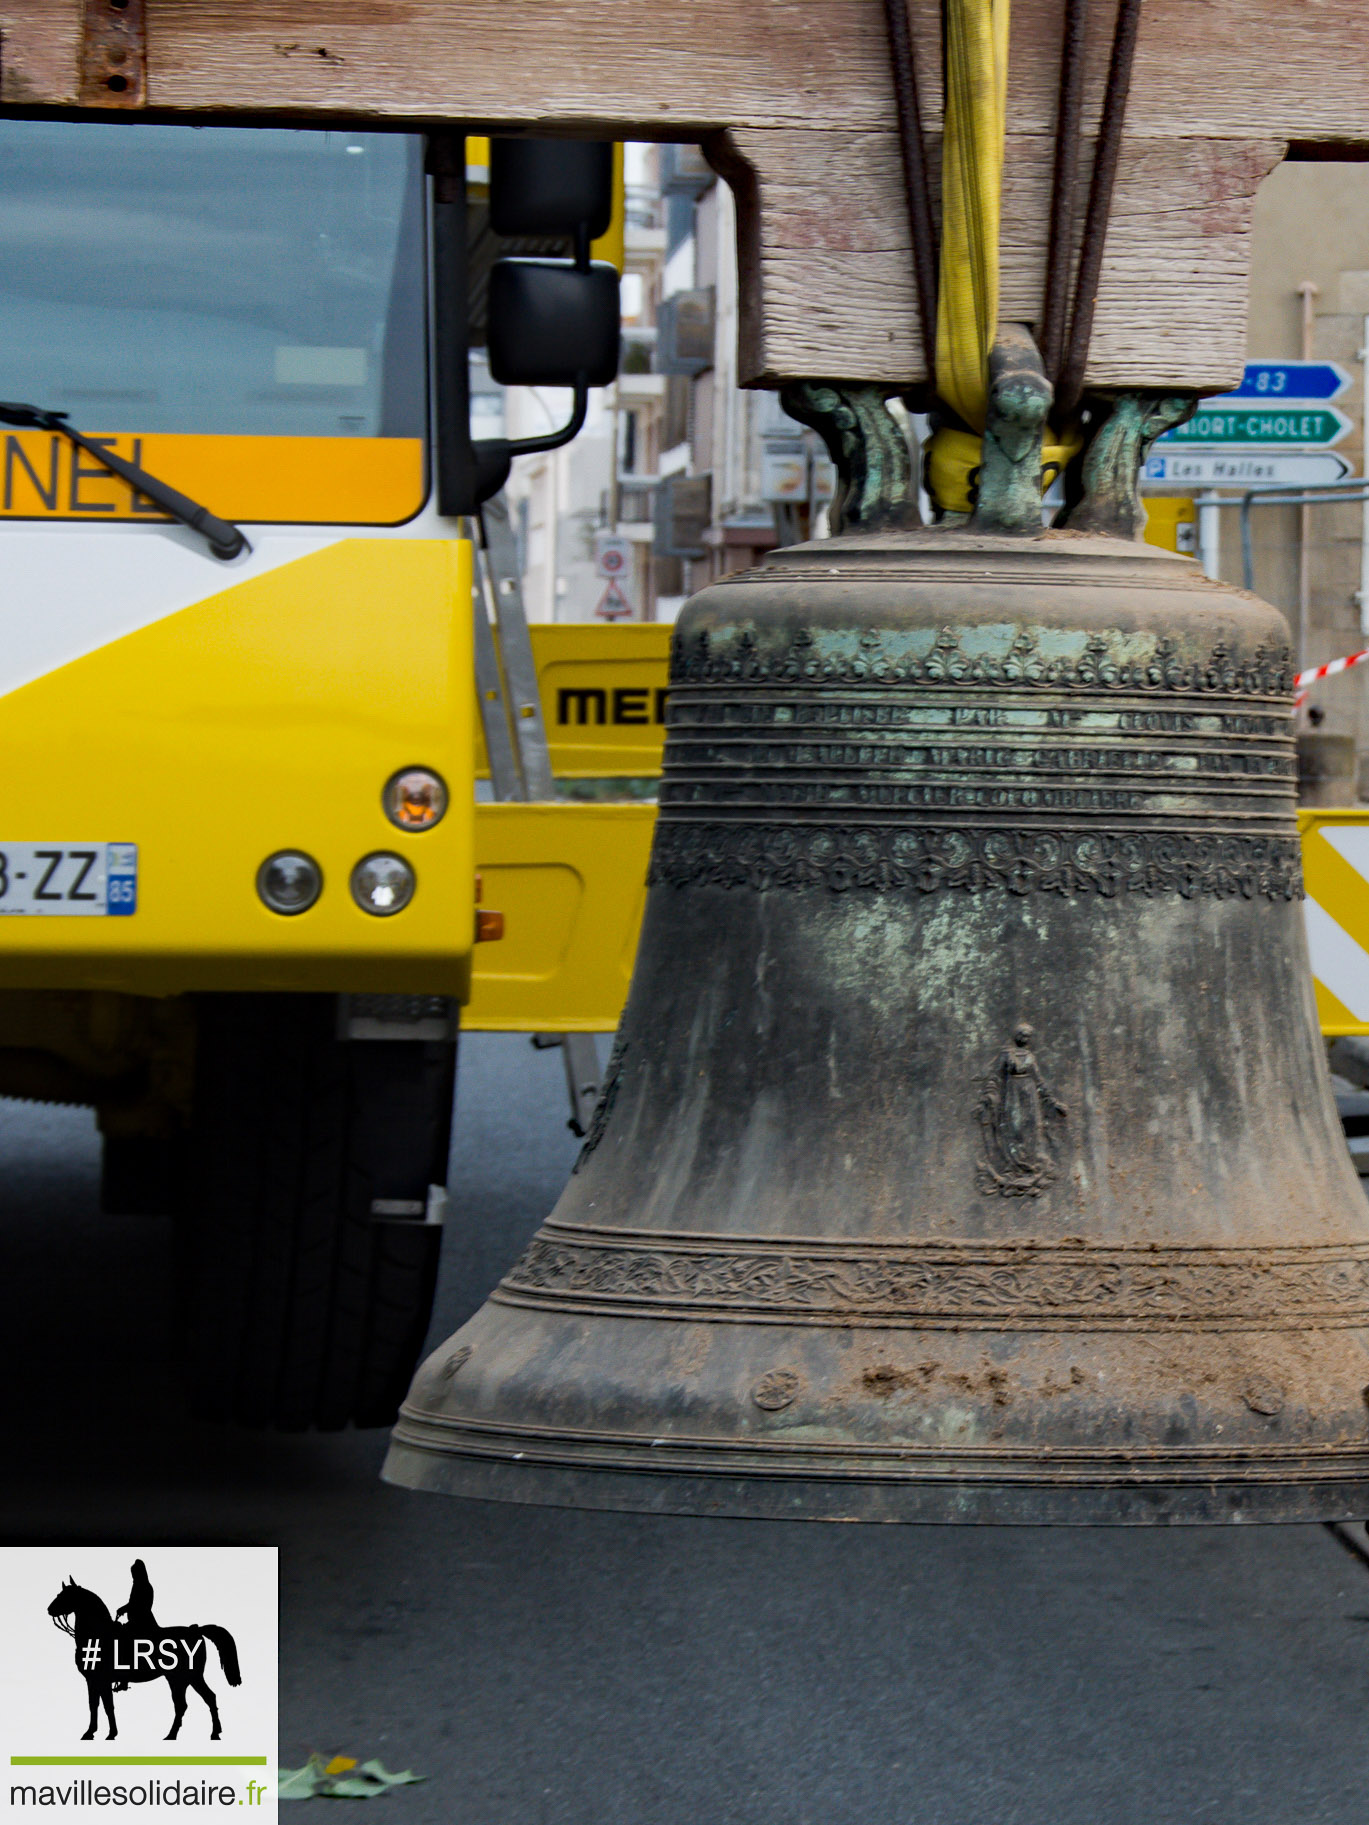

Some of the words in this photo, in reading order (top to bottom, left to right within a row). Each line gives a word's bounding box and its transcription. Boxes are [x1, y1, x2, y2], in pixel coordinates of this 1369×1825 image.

[1171, 462, 1203, 476] Les
[1212, 462, 1275, 477] Halles
[109, 880, 133, 903] 85
